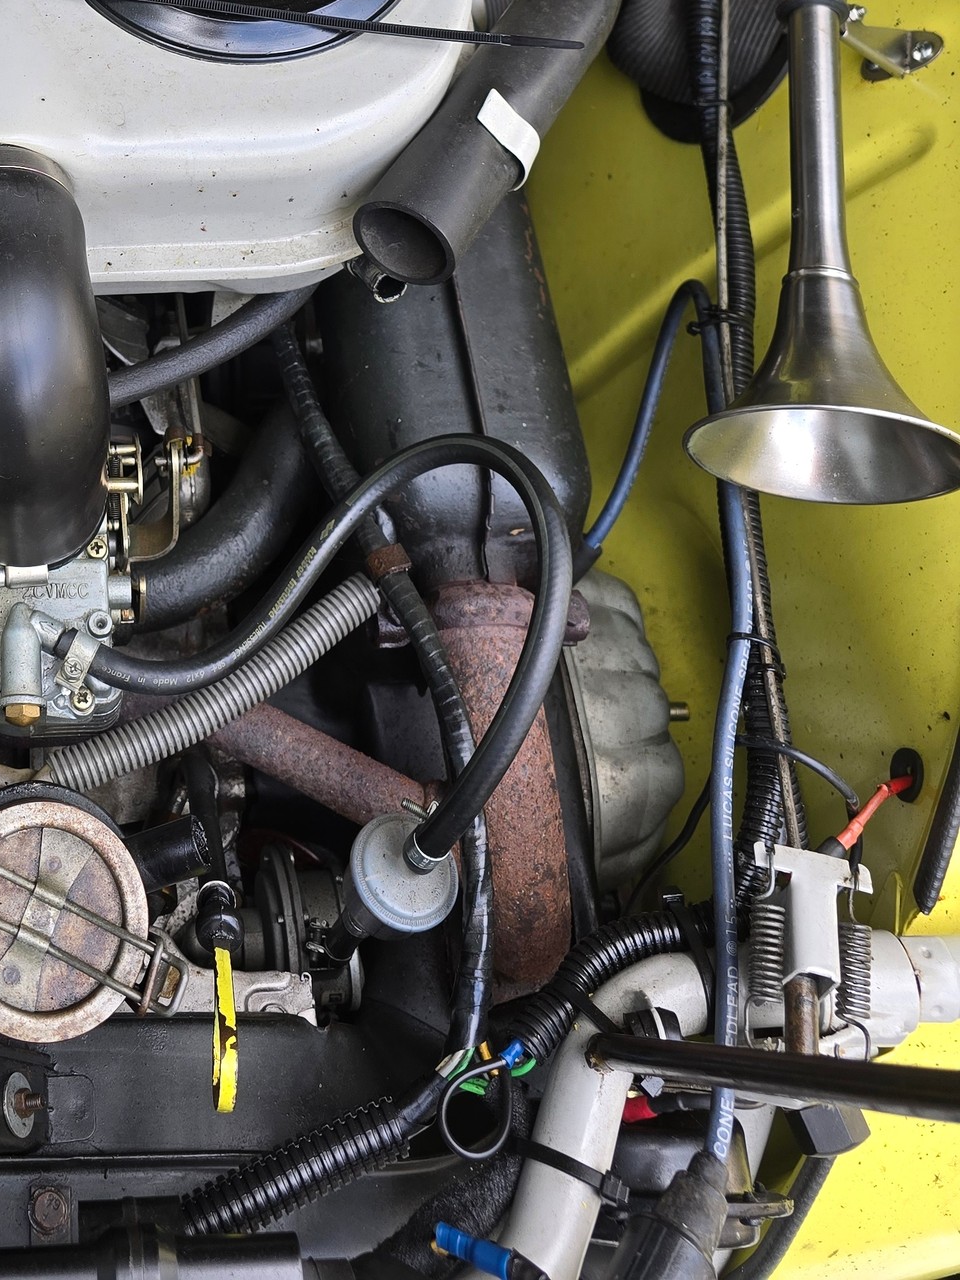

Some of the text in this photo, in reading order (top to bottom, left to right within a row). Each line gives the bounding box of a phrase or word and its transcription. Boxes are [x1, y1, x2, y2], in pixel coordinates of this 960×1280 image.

[101, 665, 131, 683] France
[153, 677, 178, 686] Made
[725, 684, 742, 770] SILICONE
[723, 777, 734, 841] LUCAS
